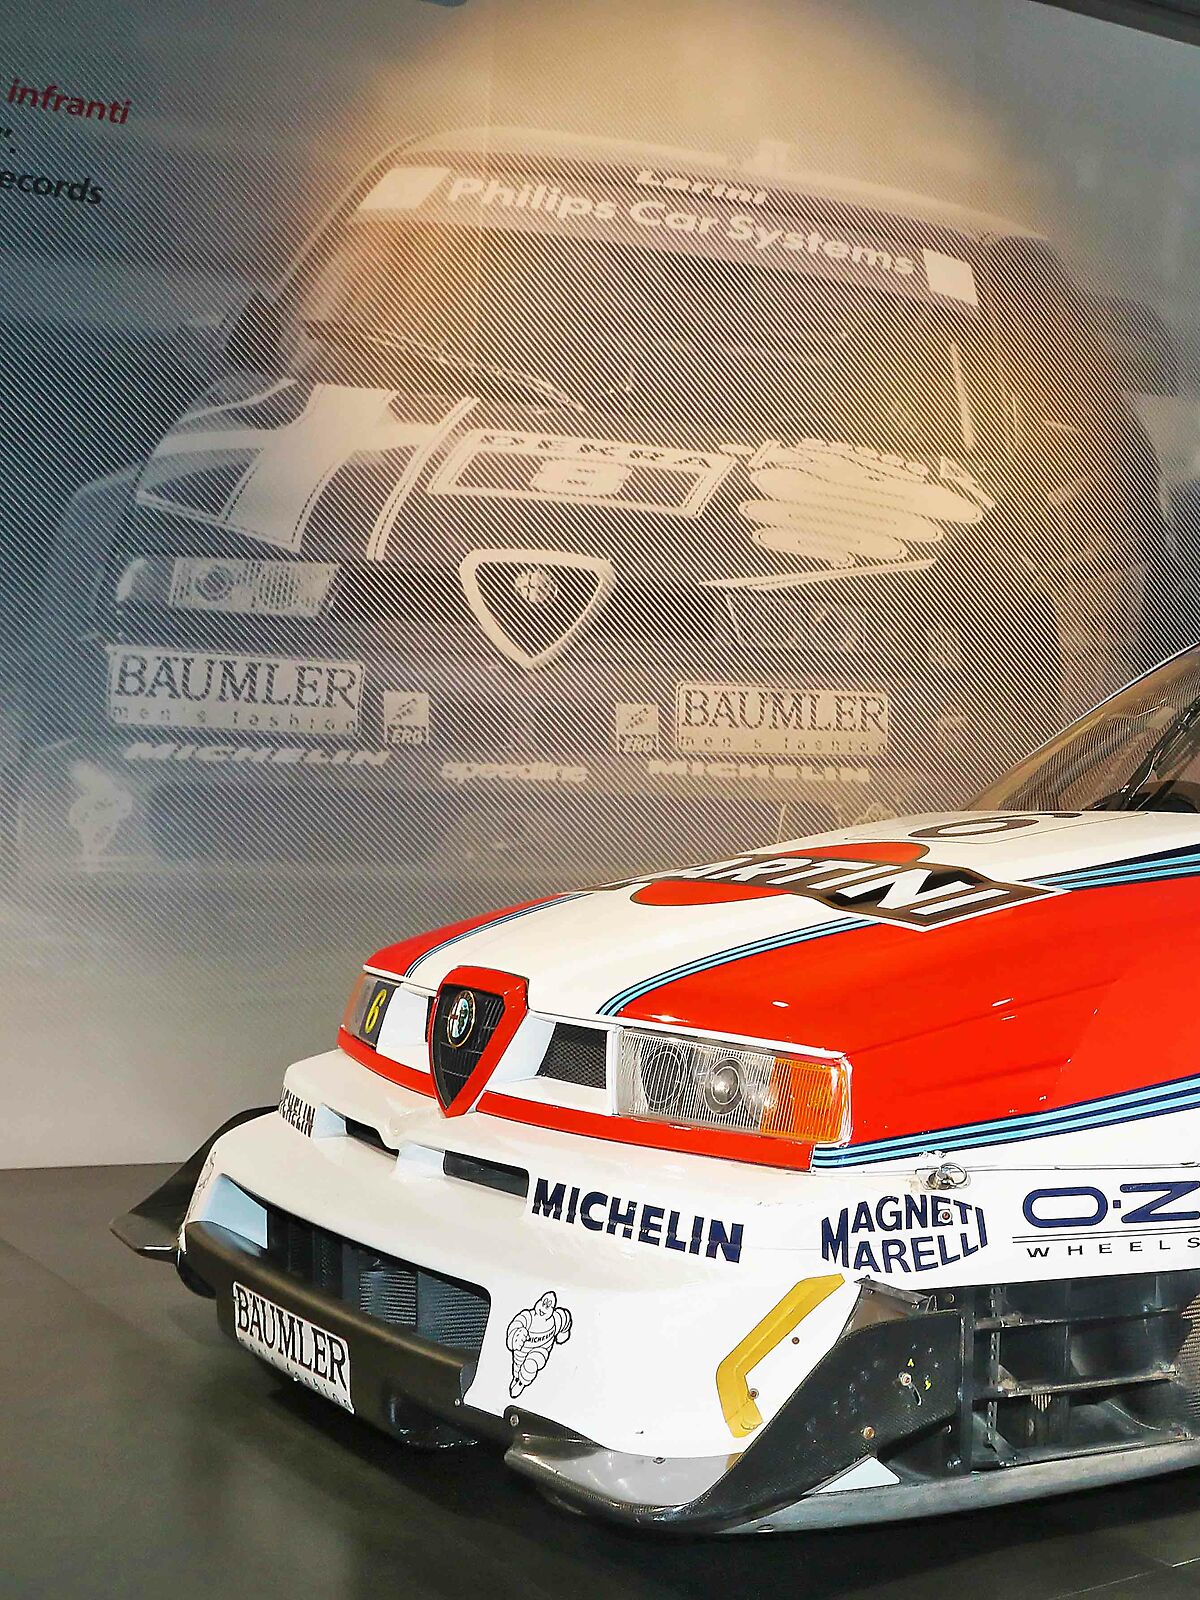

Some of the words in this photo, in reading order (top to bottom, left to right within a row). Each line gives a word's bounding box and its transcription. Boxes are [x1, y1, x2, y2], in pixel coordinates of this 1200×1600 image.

[8, 79, 132, 124] infranti
[450, 178, 617, 221] Philips
[630, 199, 719, 234] Car
[727, 214, 917, 275] Systems
[363, 988, 389, 1034] 6
[531, 1178, 745, 1263] MICHELIN
[822, 1193, 988, 1252] MAGNETI
[235, 1284, 348, 1392] BÄUMLER
